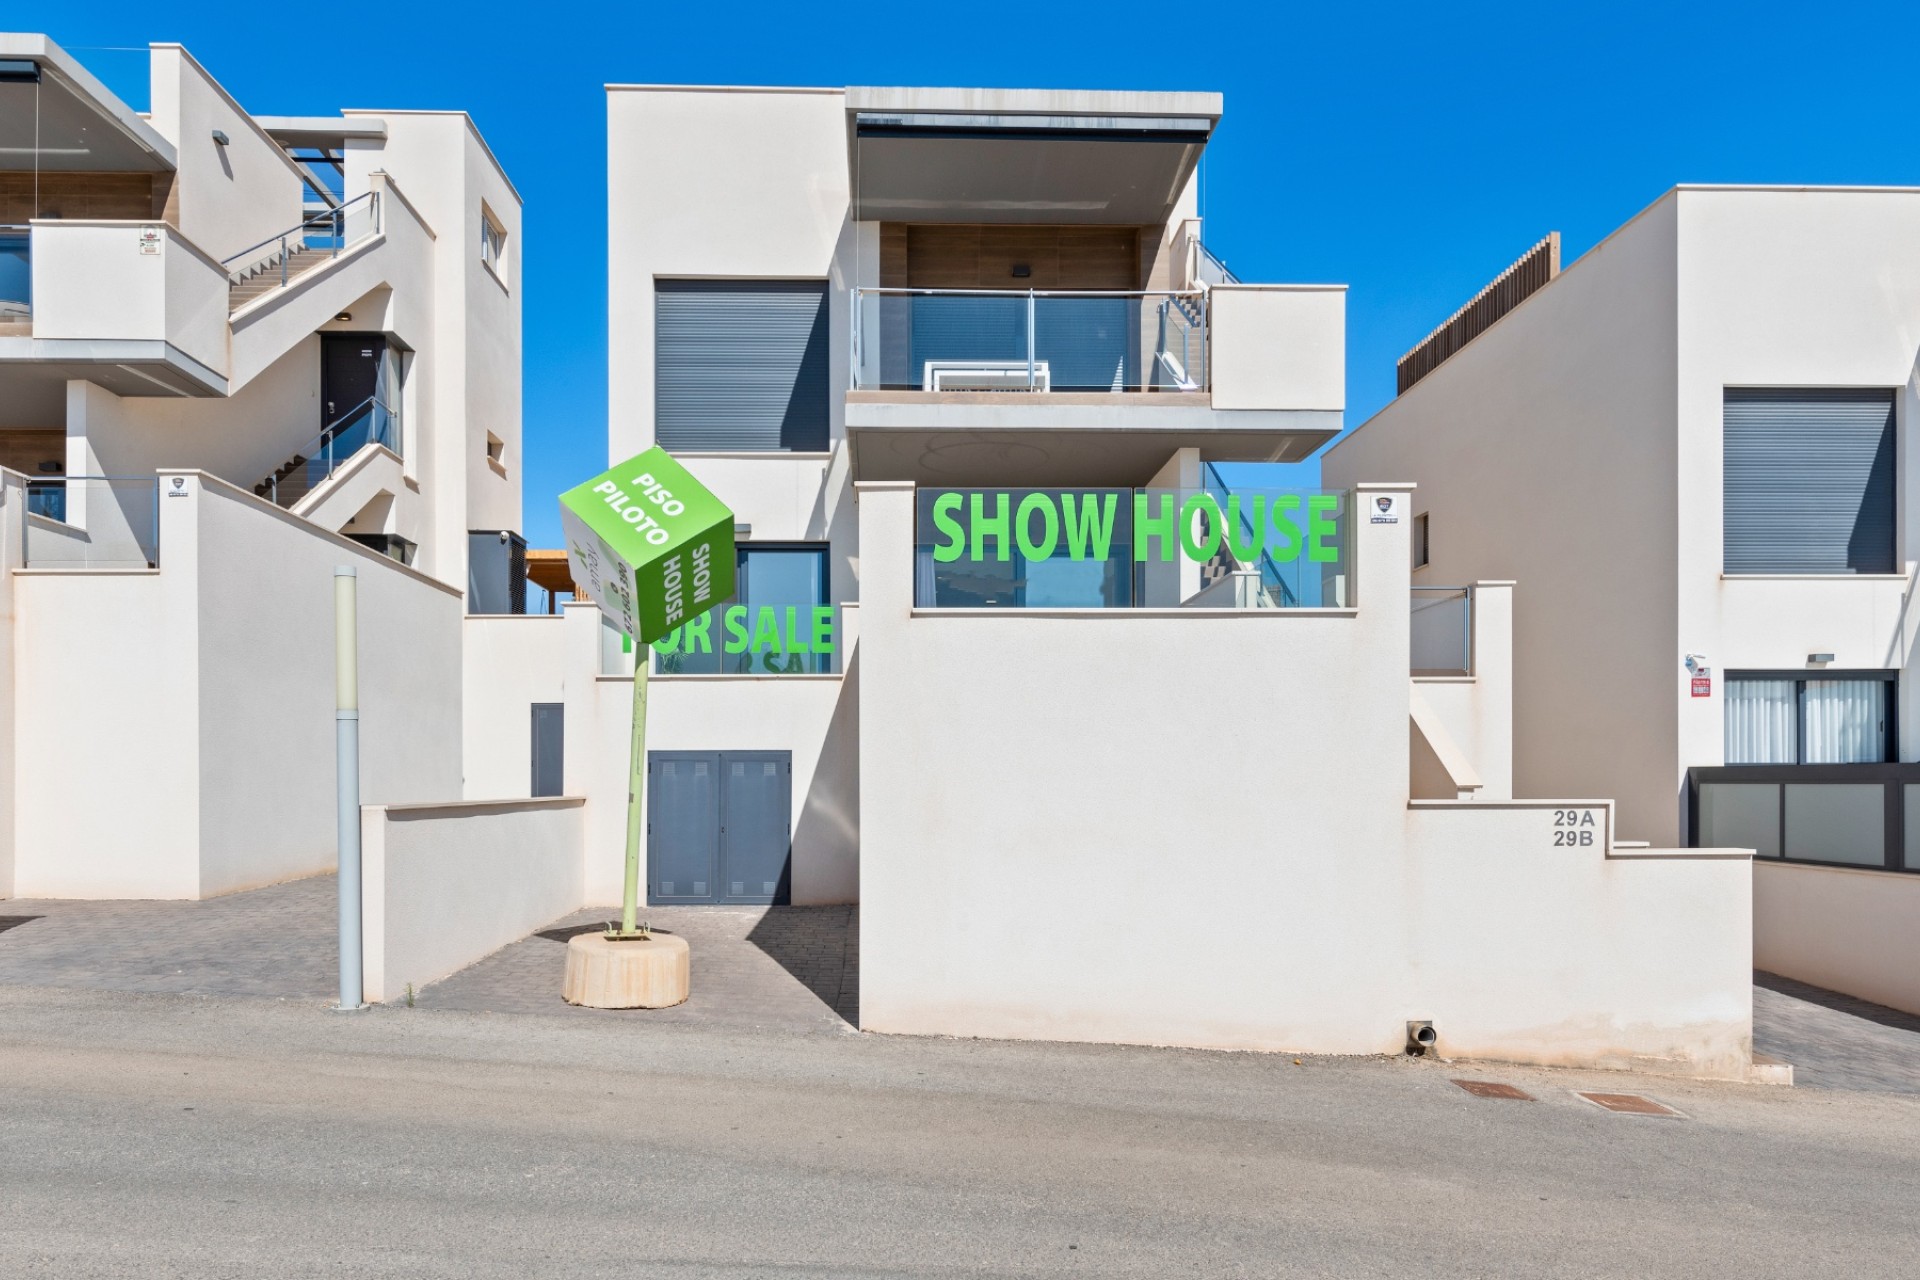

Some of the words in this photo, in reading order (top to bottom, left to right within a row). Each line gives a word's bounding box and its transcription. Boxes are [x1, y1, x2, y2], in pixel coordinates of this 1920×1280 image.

[592, 480, 669, 545] PILOTO
[632, 473, 684, 516] PISO
[933, 492, 1118, 562] SHOW
[1134, 494, 1338, 562] HOUSE
[663, 554, 683, 626] HOUSE
[692, 543, 711, 604] SHOW
[725, 605, 836, 654] SALE
[1554, 810, 1595, 826] 29A
[1554, 831, 1594, 846] 29B
